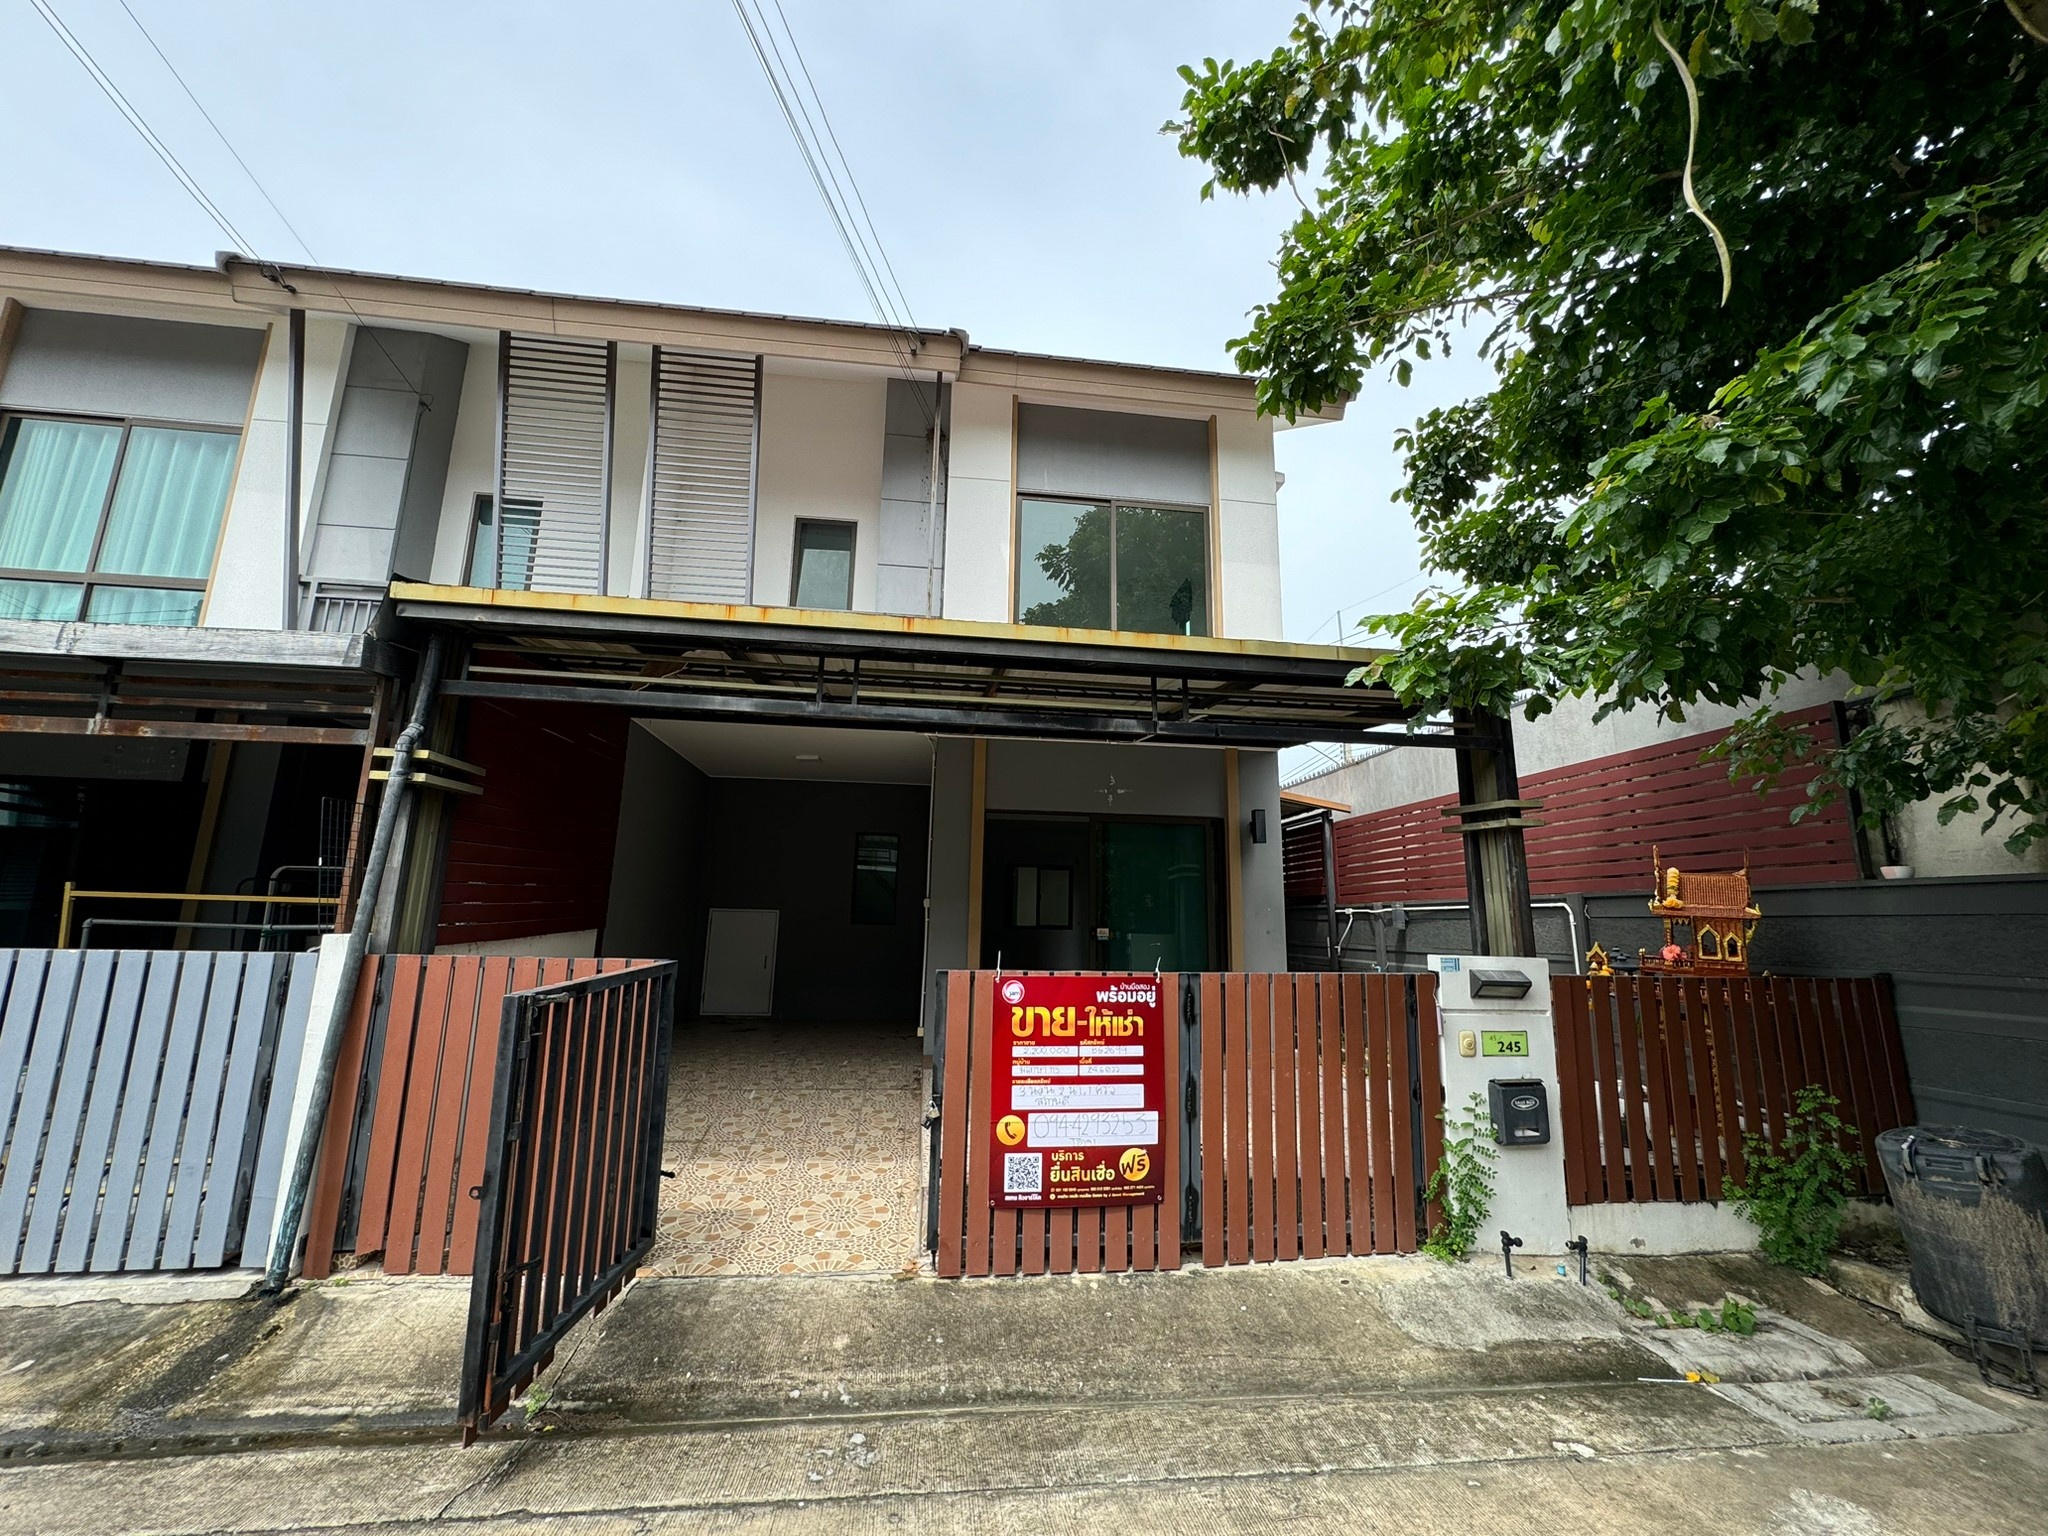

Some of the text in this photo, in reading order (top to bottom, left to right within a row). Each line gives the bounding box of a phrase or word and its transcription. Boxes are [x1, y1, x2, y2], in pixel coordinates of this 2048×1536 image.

[1119, 982, 1151, 990] บ้านมือสอง
[1096, 985, 1156, 1008] พร้อมอยู่
[1497, 1041, 1521, 1053] 245
[1051, 1150, 1085, 1162] บริการ
[1050, 1161, 1116, 1182] ยื่นสินเชื่อ
[1121, 1154, 1147, 1176] ฟรี
